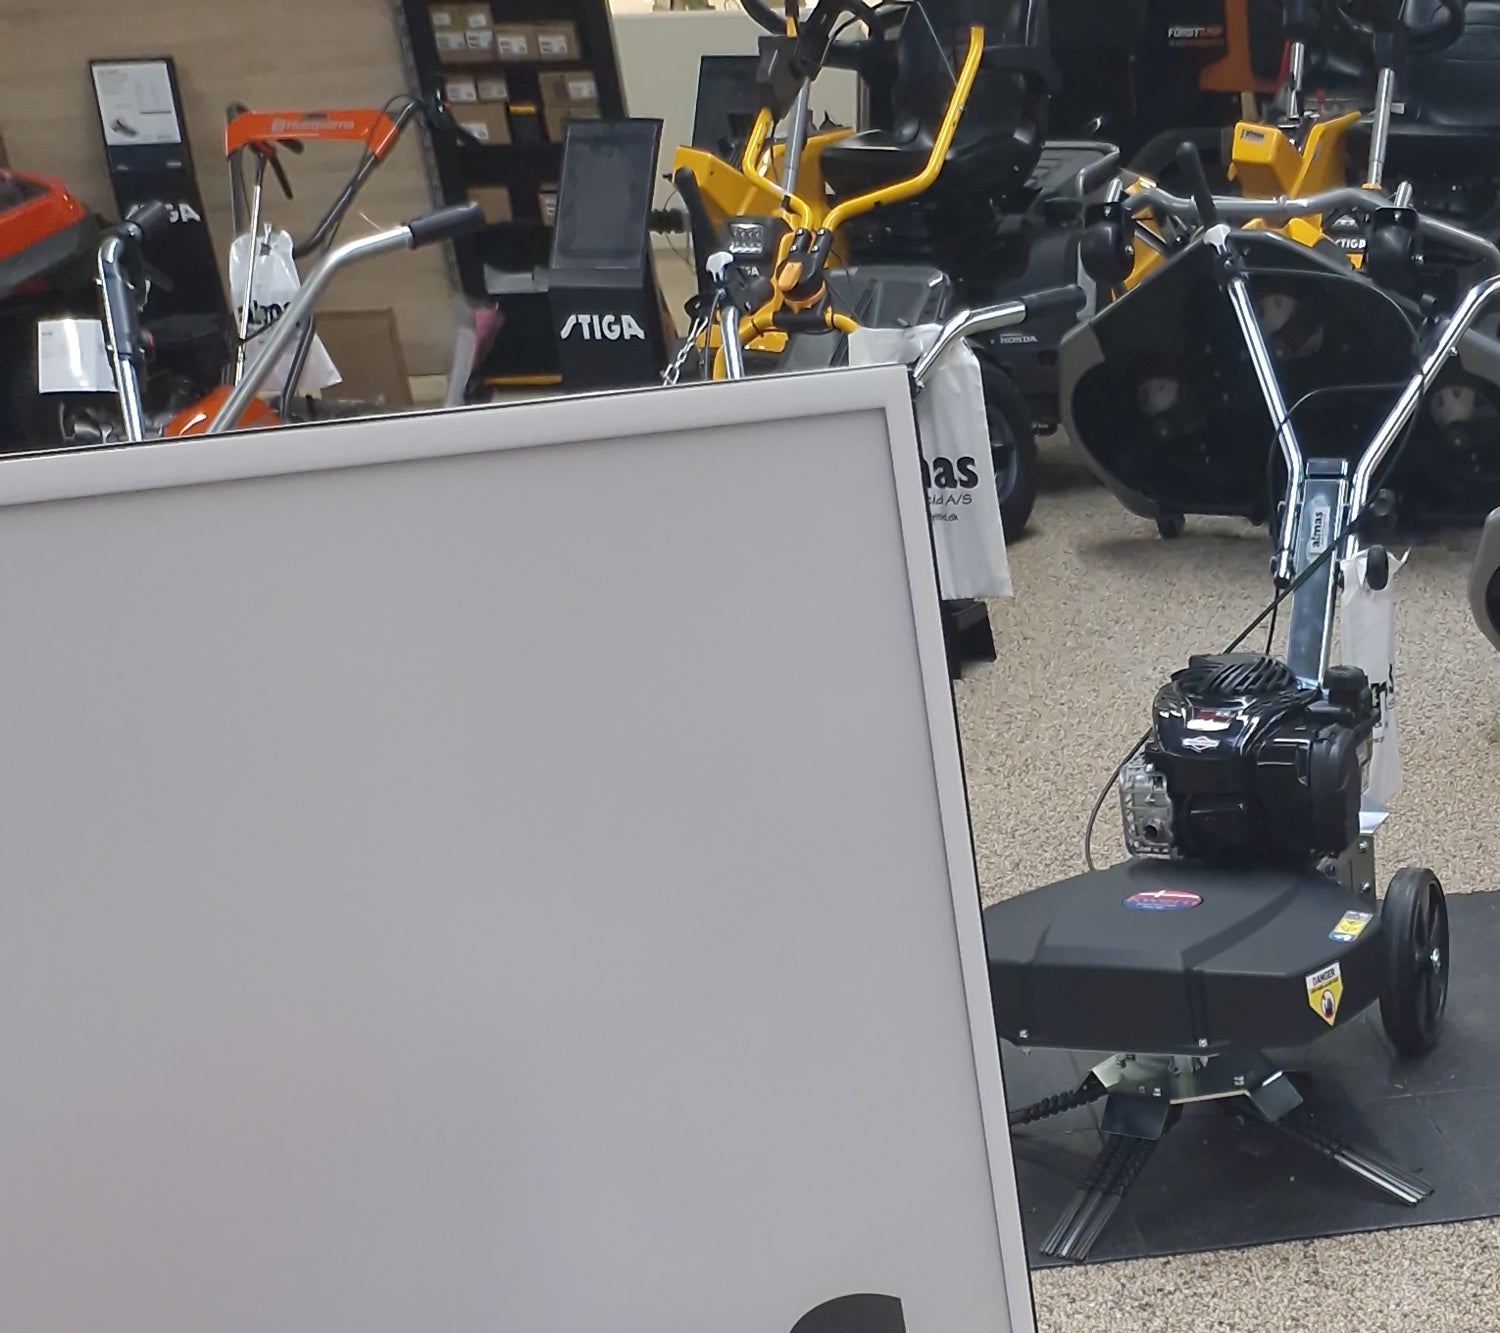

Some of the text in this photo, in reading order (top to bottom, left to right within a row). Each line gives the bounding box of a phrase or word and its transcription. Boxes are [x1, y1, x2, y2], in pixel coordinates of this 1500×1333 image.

[561, 314, 645, 340] STIGA
[1000, 335, 1037, 343] HONDA
[1311, 512, 1323, 547] almas
[1312, 968, 1336, 986] DANGER
